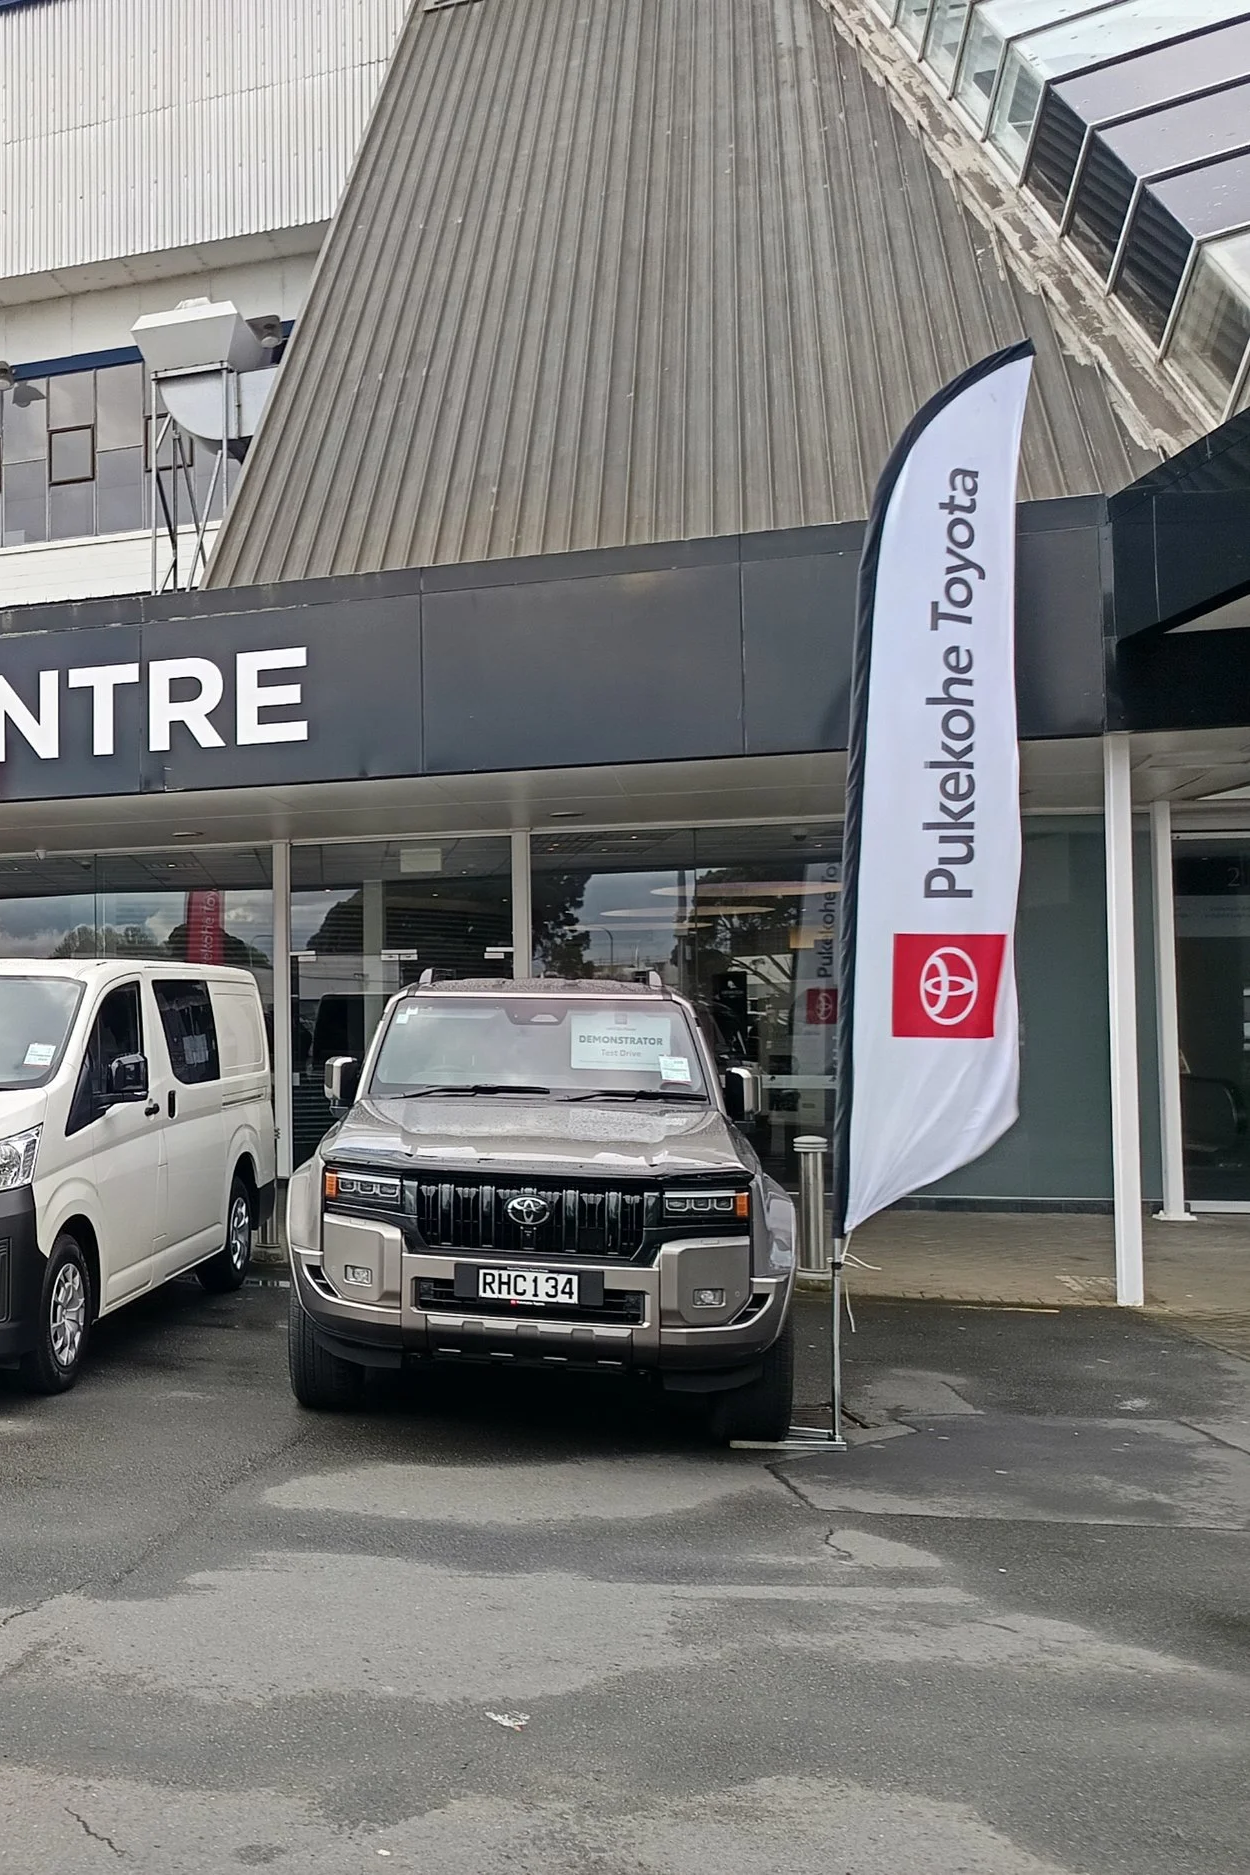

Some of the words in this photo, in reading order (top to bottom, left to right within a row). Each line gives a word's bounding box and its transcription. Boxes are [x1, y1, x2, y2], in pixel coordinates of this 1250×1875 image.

[929, 467, 985, 631] Toyota
[922, 645, 975, 898] Pukekohe
[200, 916, 215, 964] ekohe
[578, 1034, 663, 1046] DEMONSTRATOR
[601, 1048, 618, 1056] Test
[619, 1049, 642, 1057] Drive
[482, 1272, 574, 1300] RHC134
